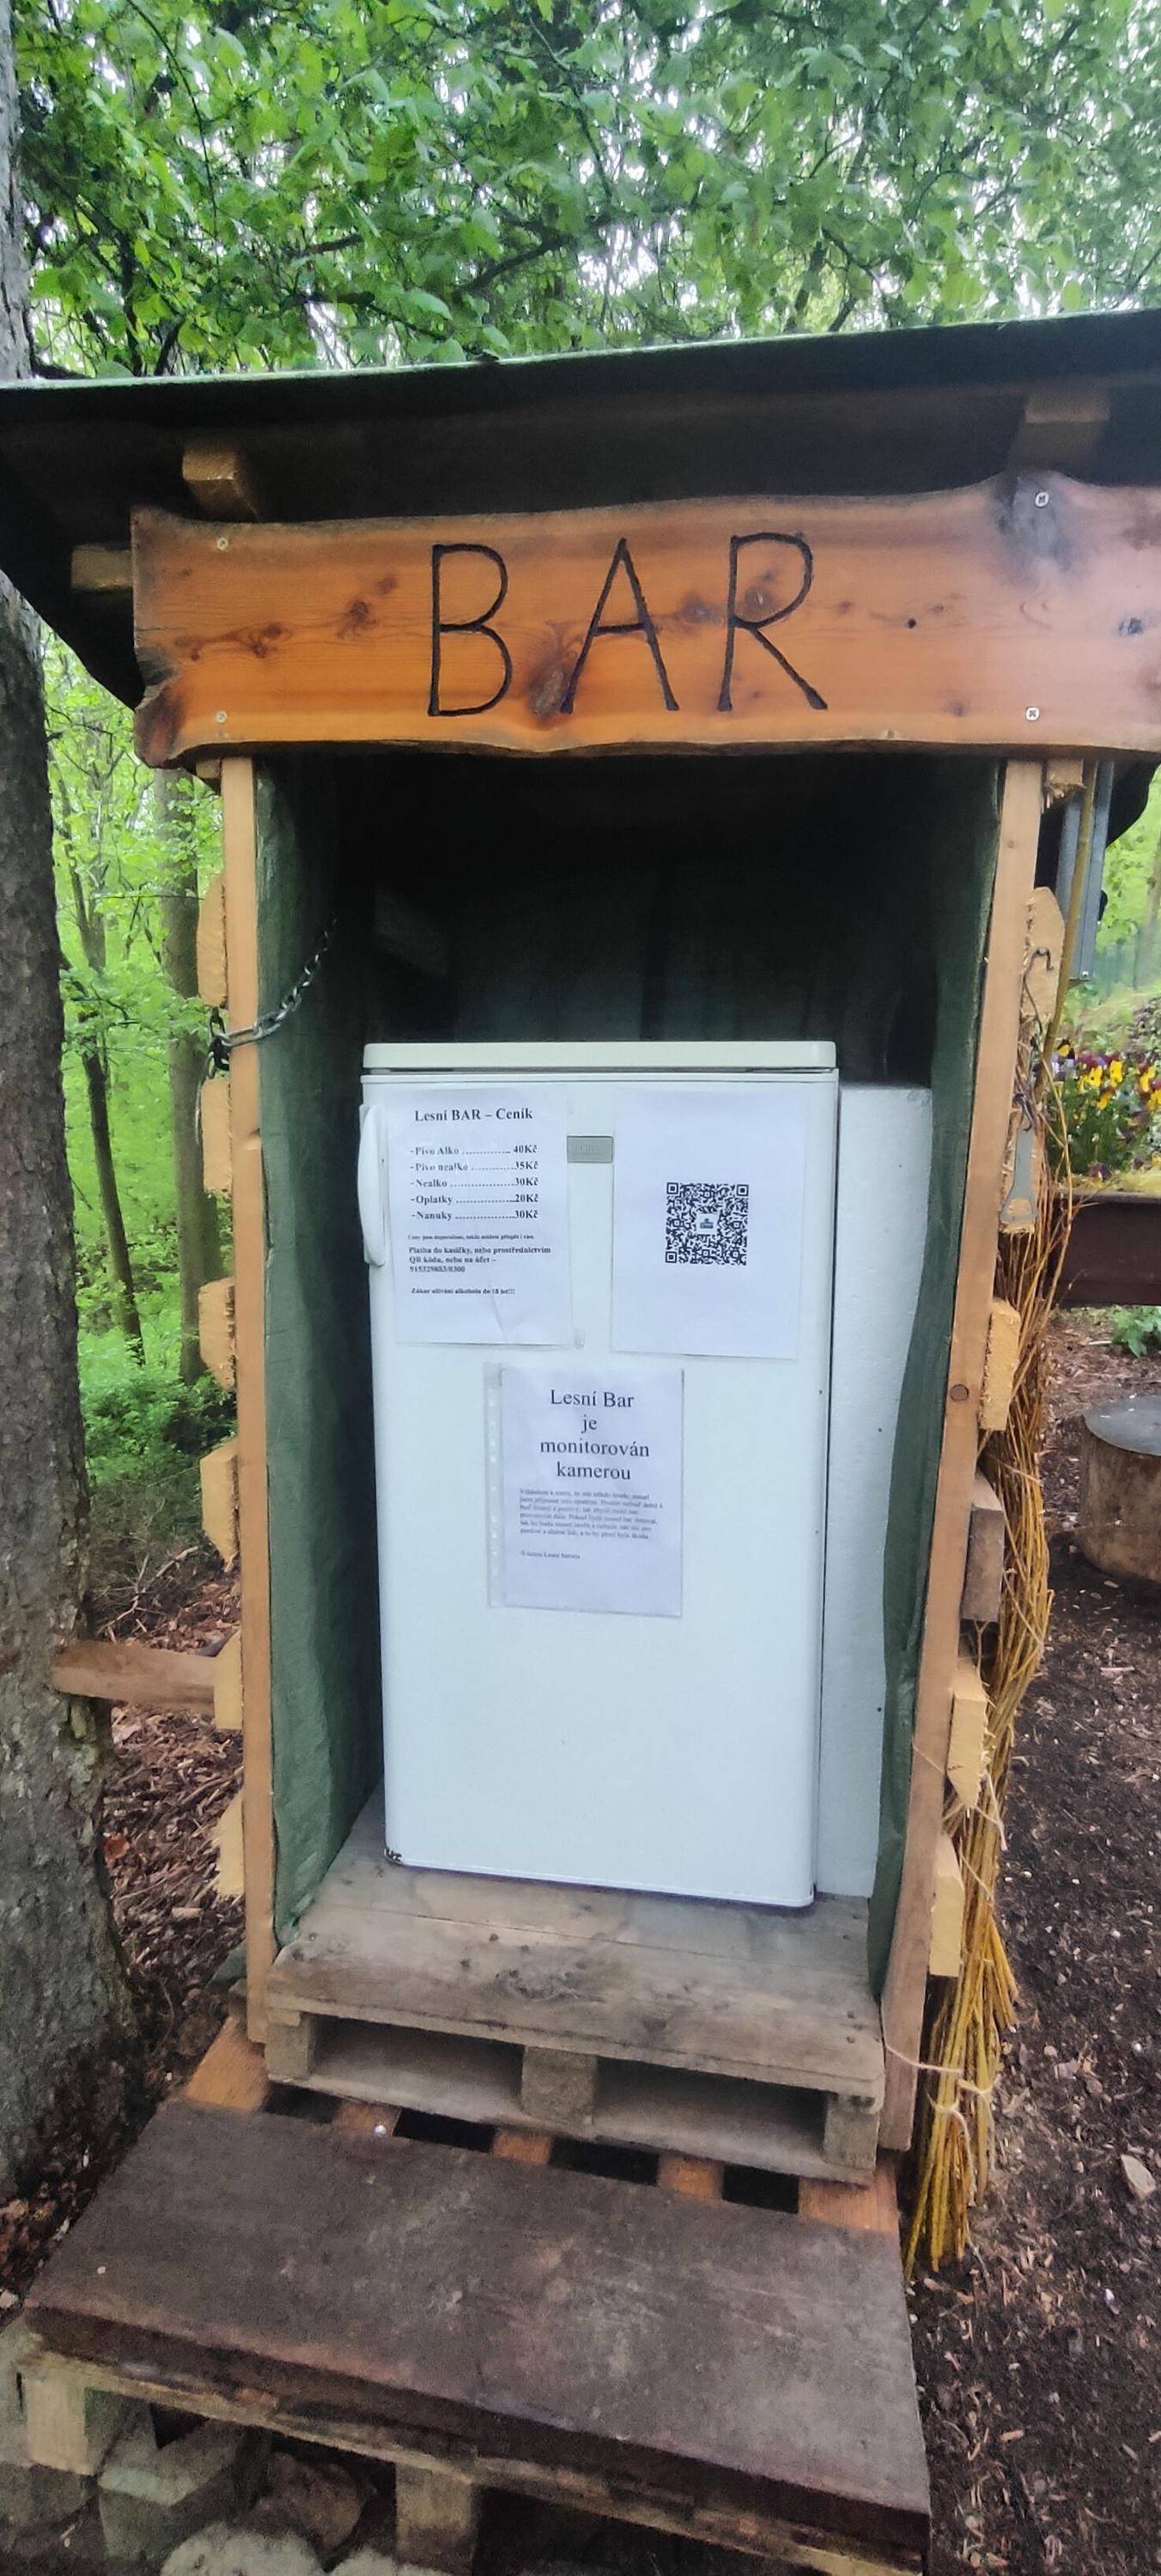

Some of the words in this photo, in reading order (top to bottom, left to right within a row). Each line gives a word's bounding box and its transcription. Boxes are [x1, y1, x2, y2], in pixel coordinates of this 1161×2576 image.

[428, 531, 830, 718] BAR
[415, 1109, 447, 1121] Lesní
[452, 1108, 481, 1121] BAR
[495, 1107, 533, 1120] Ceník
[437, 1146, 459, 1155] Alko
[438, 1163, 468, 1171] nealko
[550, 1388, 597, 1406] Lesní
[603, 1391, 635, 1408] Bar
[580, 1414, 598, 1434] je
[540, 1437, 650, 1457] monitorován
[556, 1461, 632, 1480] kamerou
